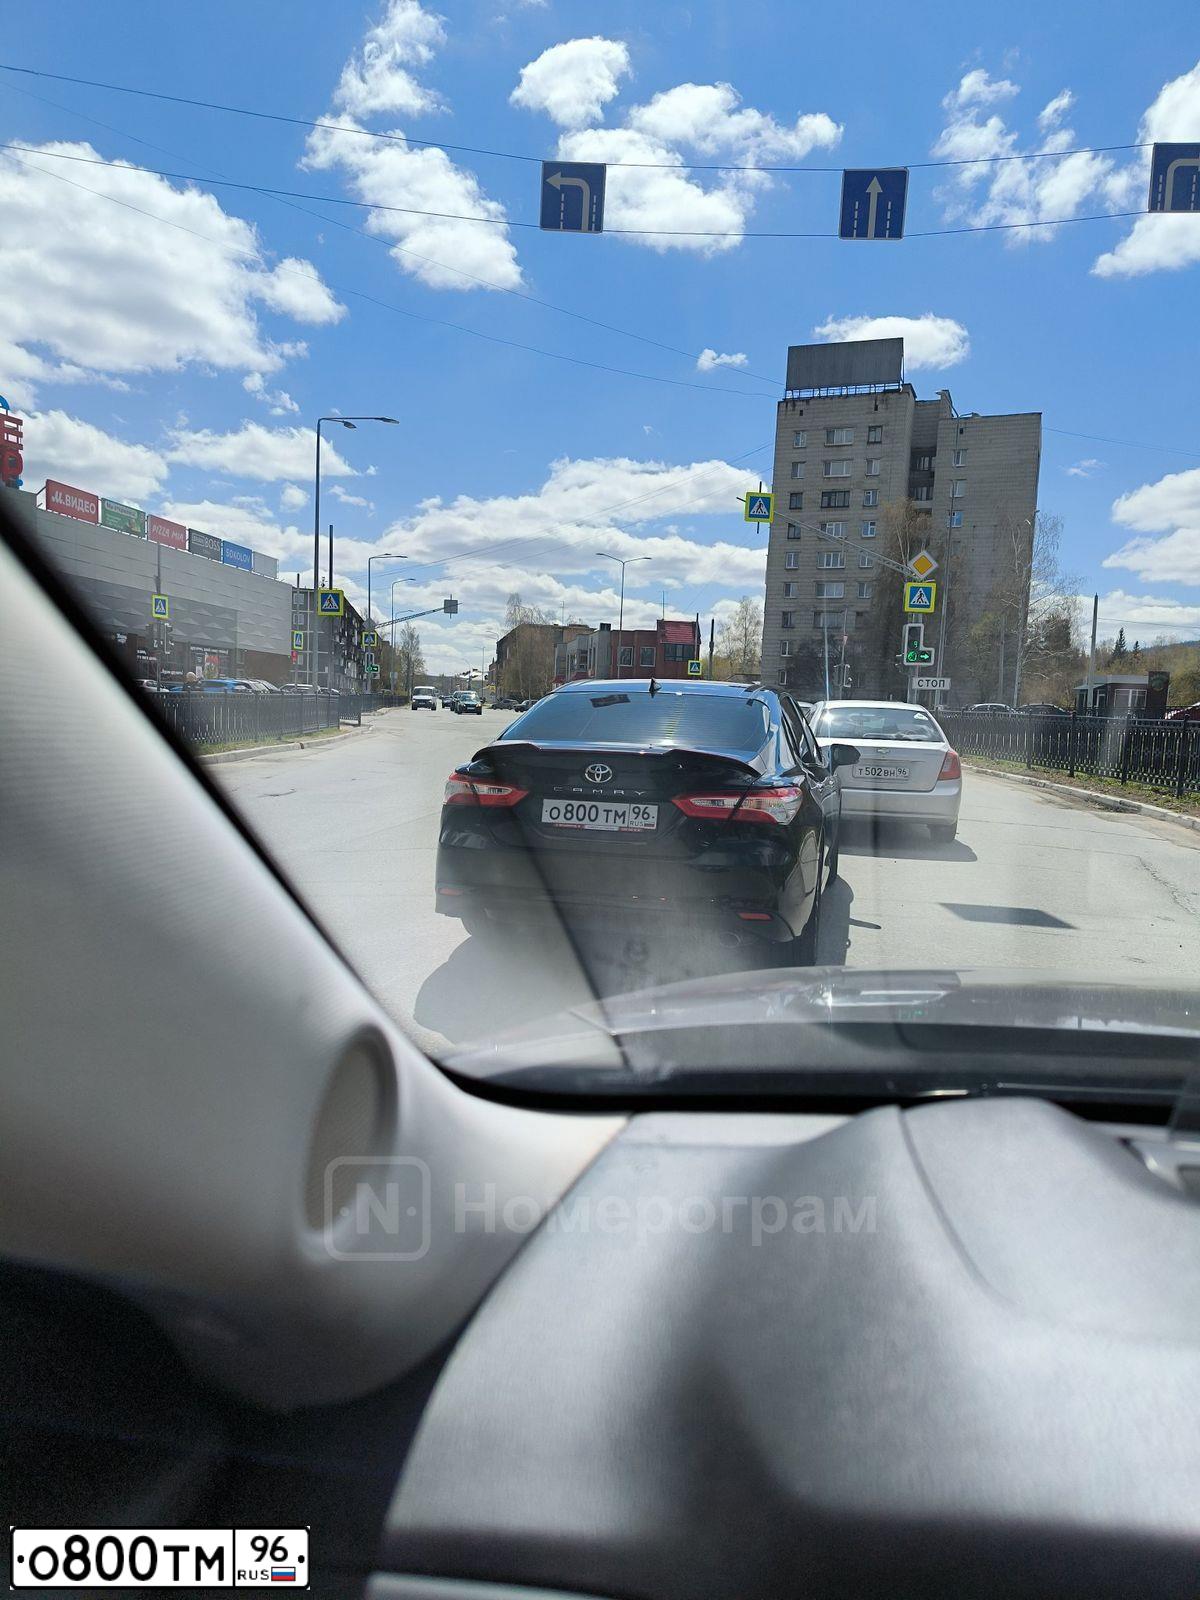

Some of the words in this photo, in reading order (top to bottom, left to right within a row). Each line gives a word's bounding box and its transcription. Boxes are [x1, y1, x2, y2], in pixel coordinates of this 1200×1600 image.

[225, 547, 251, 564] SOKOLOV
[917, 679, 945, 688] СТОП
[553, 785, 645, 797] CAMRY
[549, 803, 627, 824] О800ТМ
[632, 805, 651, 820] 96
